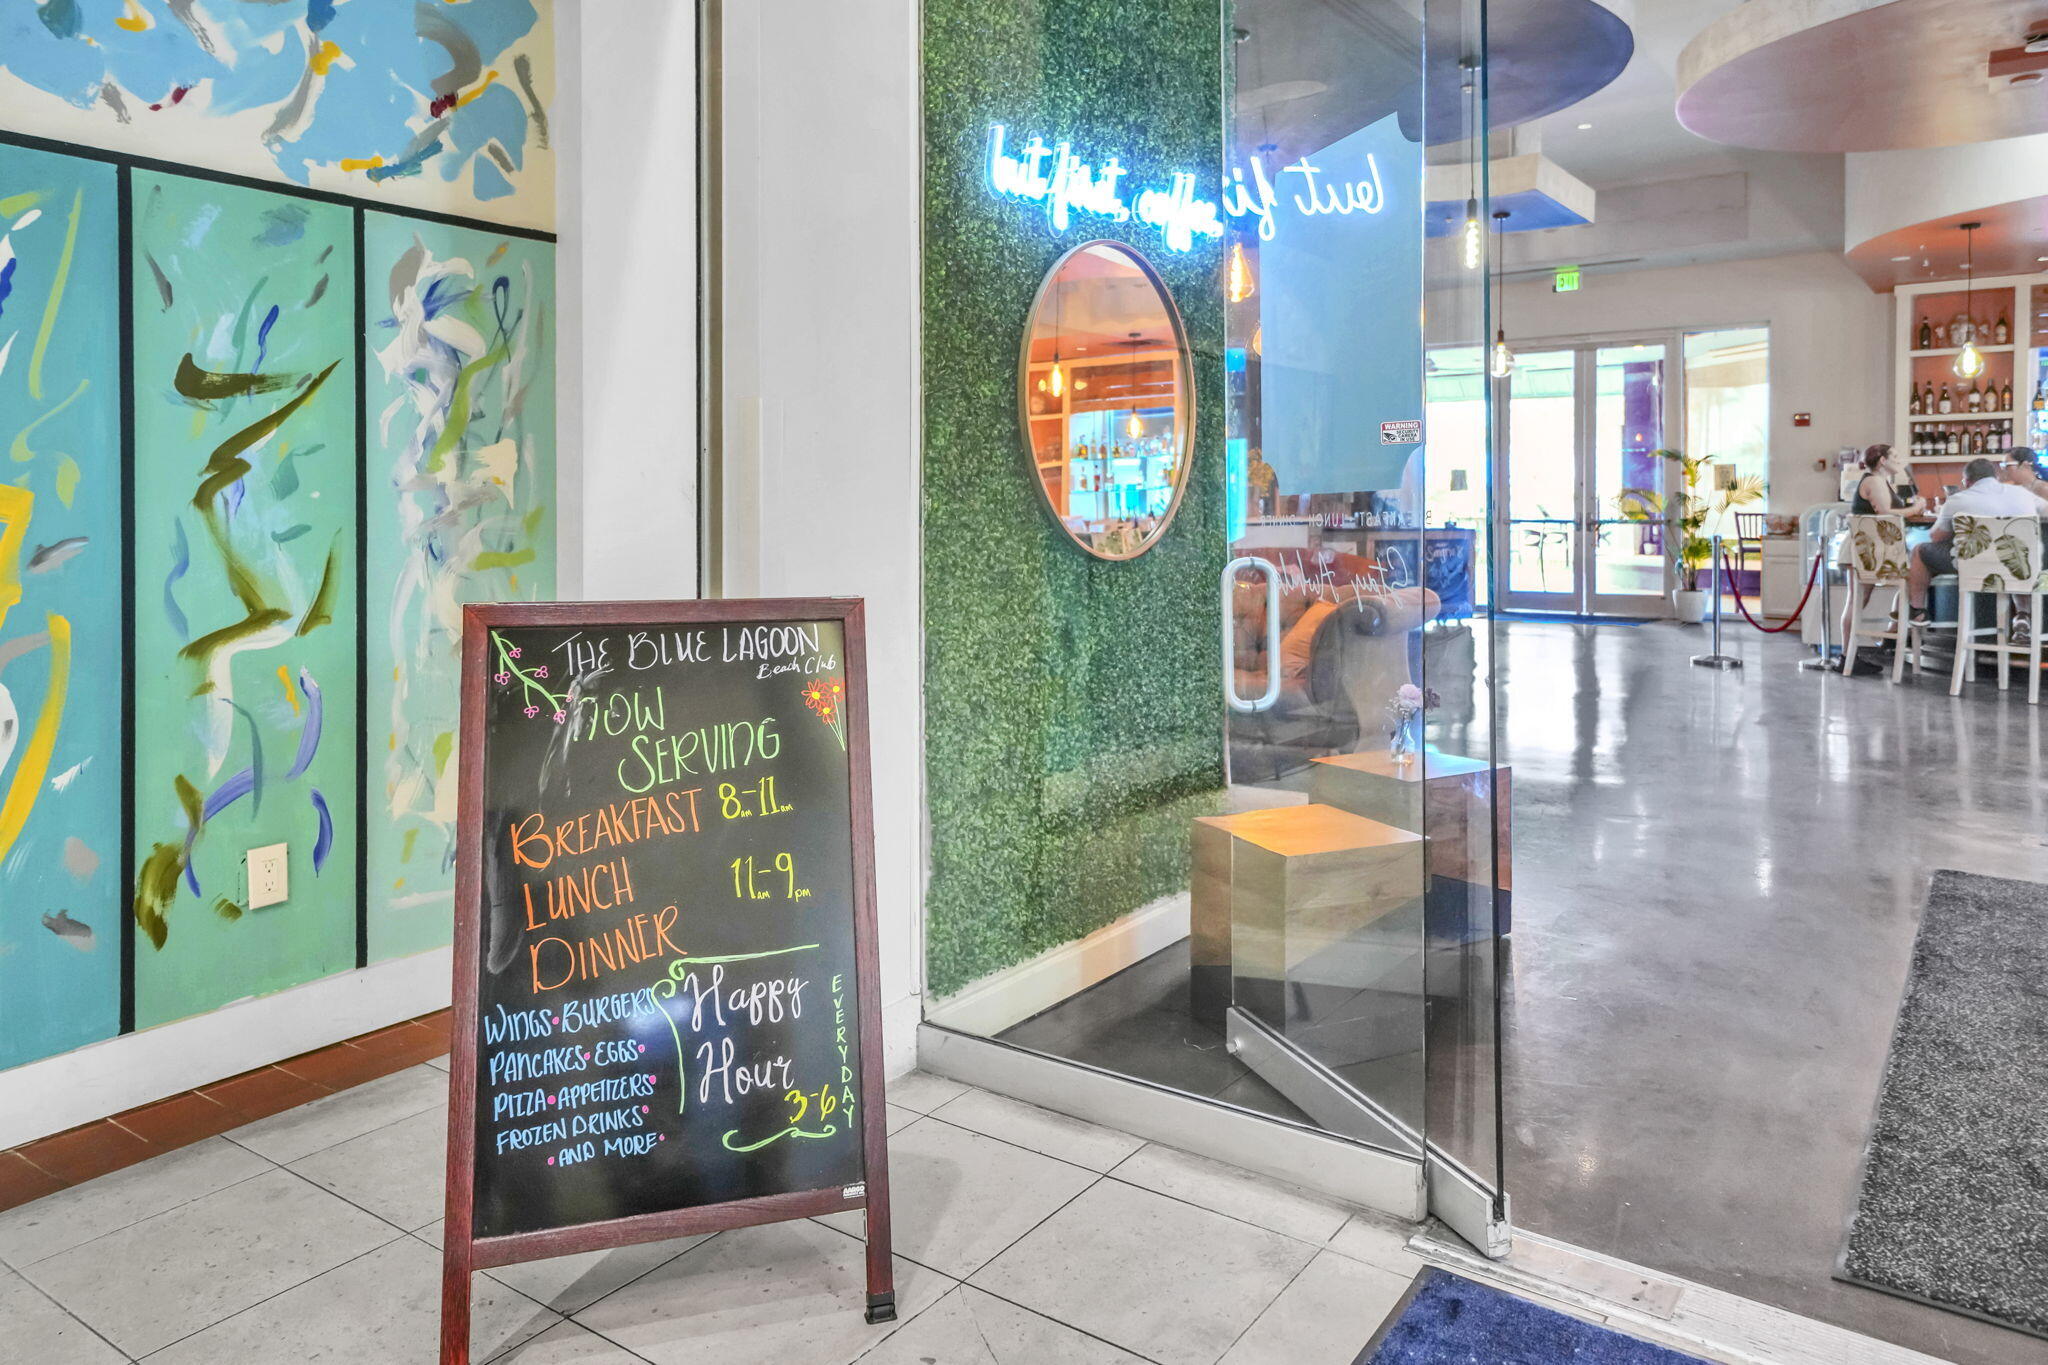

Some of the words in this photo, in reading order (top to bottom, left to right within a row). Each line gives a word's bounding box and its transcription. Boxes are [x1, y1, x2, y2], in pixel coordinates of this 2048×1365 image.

[1384, 422, 1418, 430] WARNING
[552, 631, 613, 676] THE
[628, 630, 711, 670] BLUE
[723, 623, 819, 663] LAGOON
[756, 661, 800, 680] Beach
[804, 654, 837, 675] Club
[617, 717, 780, 793] SERVING
[511, 788, 703, 870] BREAKFAST
[524, 856, 634, 931] LUNCH
[530, 906, 687, 994] DINNER
[484, 1004, 552, 1045] WINGS
[561, 988, 656, 1033] BURGERS
[683, 964, 808, 1031] Happy
[489, 1045, 586, 1085] PANCAKES
[594, 1039, 639, 1066] EGGS
[696, 1037, 795, 1104] Hour
[493, 1087, 547, 1122] PIZZA
[496, 1119, 568, 1155] FROZEN
[572, 1105, 644, 1137] DRINKS
[784, 1084, 836, 1123] 3-6
[558, 1139, 595, 1167] AND
[604, 1133, 657, 1158] MORE
